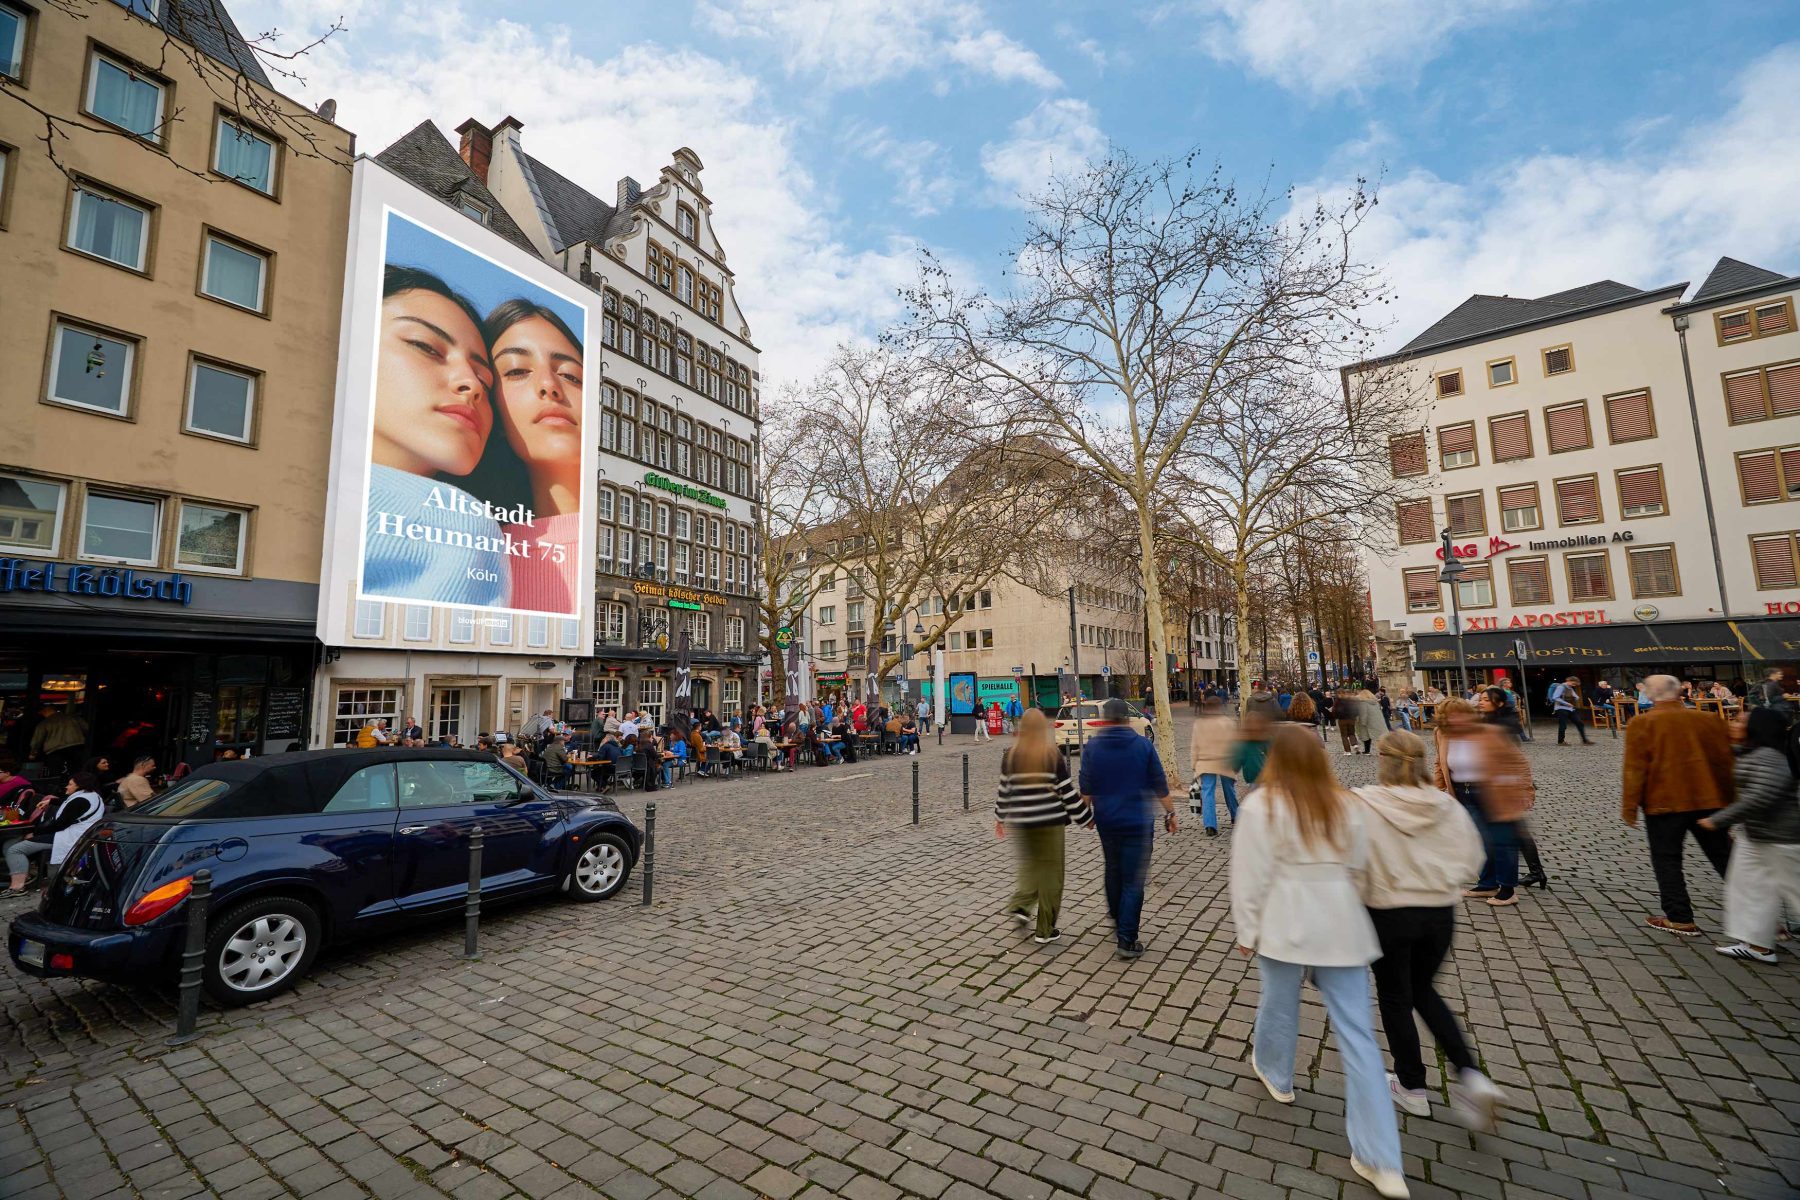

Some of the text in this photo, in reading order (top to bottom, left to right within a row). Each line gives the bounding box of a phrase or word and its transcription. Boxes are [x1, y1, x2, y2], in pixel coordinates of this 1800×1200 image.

[423, 486, 535, 528] Altstadt
[376, 511, 566, 564] Heumarkt 75
[1529, 530, 1634, 551] Immobilien AG
[69, 564, 192, 605] Kölsch
[467, 567, 498, 582] Köln
[668, 588, 701, 602] kölscher
[703, 594, 728, 605] Helden
[1466, 610, 1612, 632] XII APOSTEL
[1466, 652, 1496, 660] XII
[981, 682, 1014, 691] SPIELHALLE
